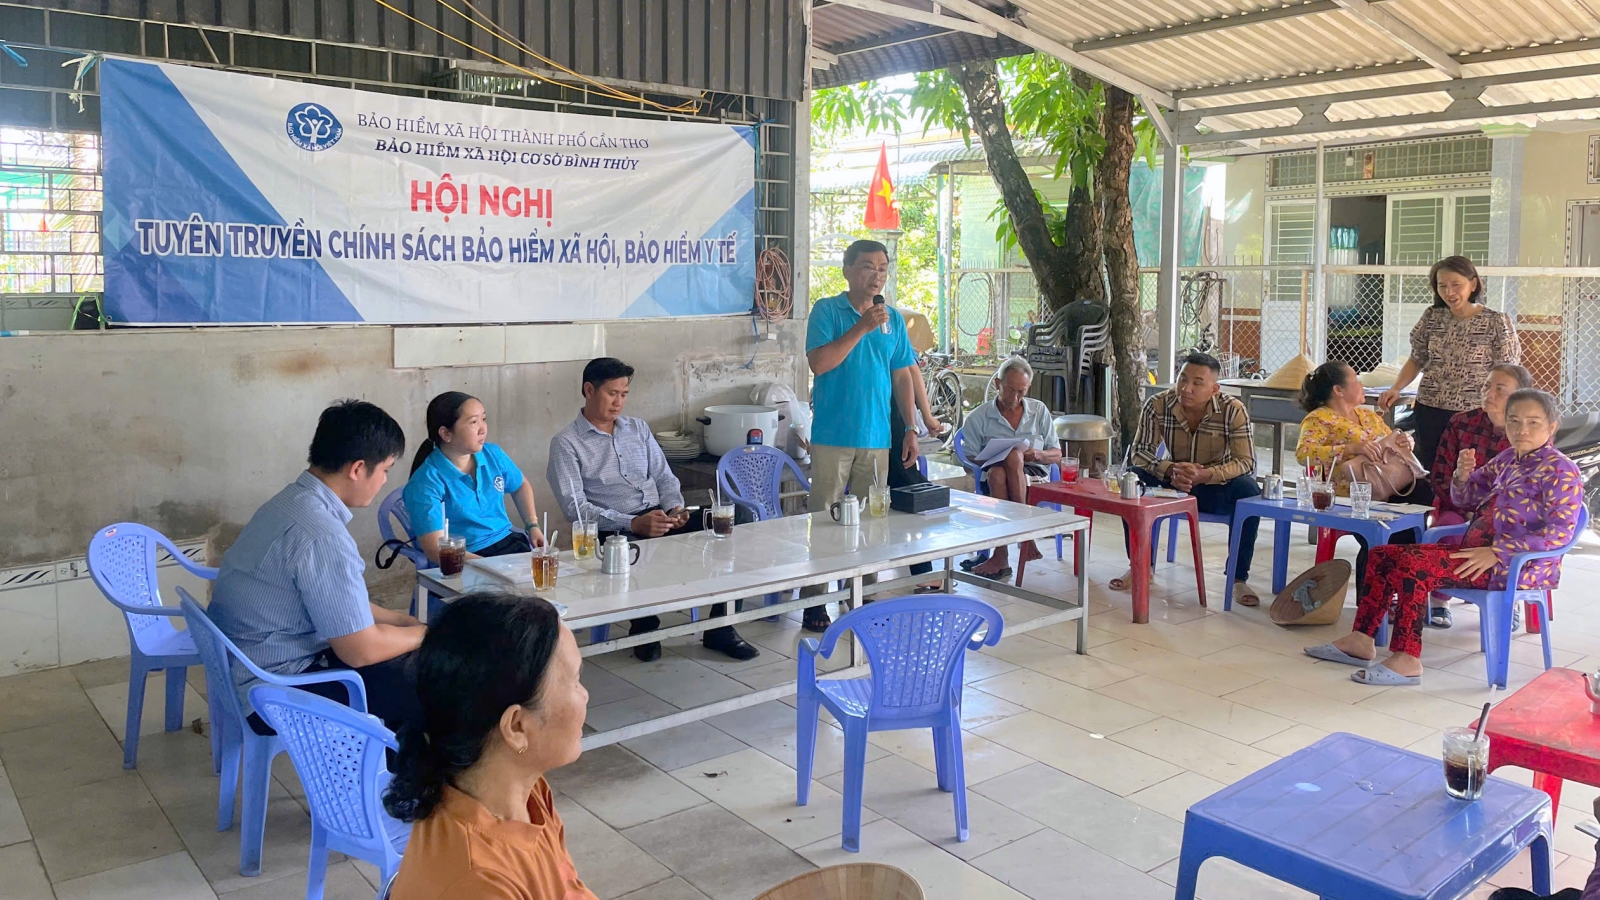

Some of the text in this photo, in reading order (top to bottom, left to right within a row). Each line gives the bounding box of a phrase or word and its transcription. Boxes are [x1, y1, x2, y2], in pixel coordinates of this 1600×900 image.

[357, 112, 649, 149] BẢO HIỂM XÃ HỘI THÀNH PHỐ CẦN THƠ
[375, 137, 639, 170] BẢO HIỂM XÃ HỘI CƠ SỞ BÌNH THỦY
[411, 173, 552, 228] HỘI NGHỊ
[137, 214, 737, 270] TUYÊN TRUYỀN CHÍNH SÁCH BẢO HIỂM XÃ HỘI, BẢO HIỂM Y TẾ
